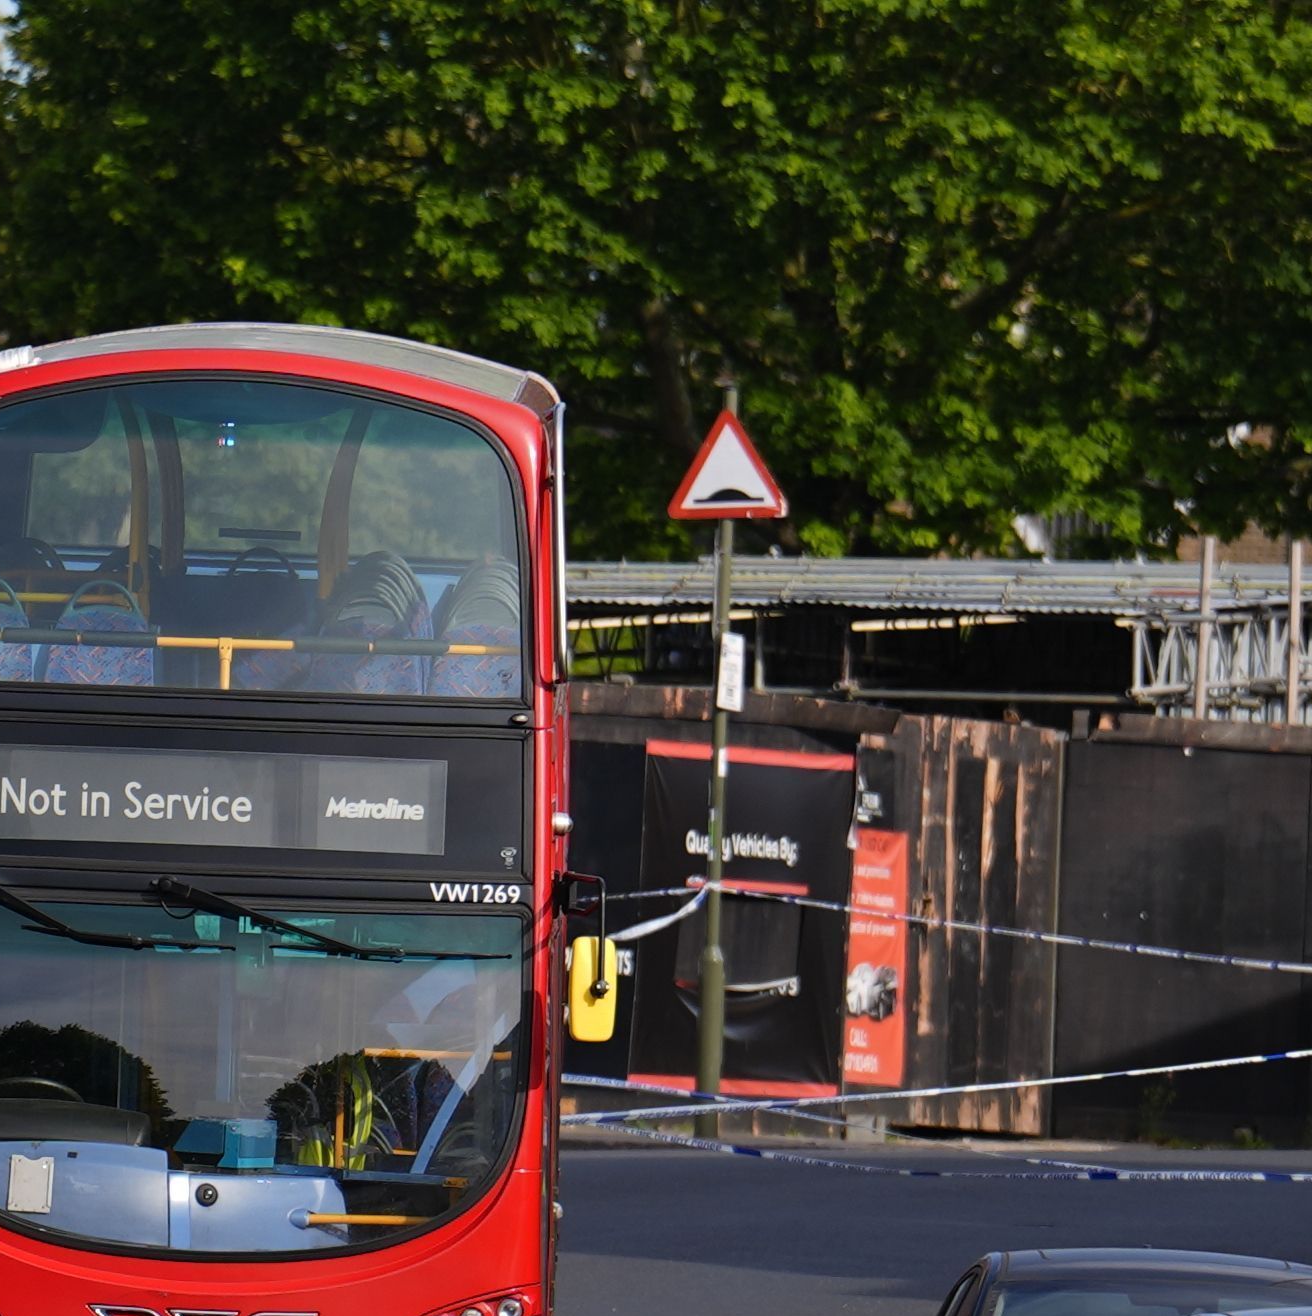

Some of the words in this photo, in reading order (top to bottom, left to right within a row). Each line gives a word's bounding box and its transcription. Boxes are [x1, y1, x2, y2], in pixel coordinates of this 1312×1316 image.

[0, 777, 66, 816] Not
[81, 782, 110, 817] in
[124, 781, 252, 822] Service
[325, 796, 425, 821] Metroline
[686, 829, 732, 862] Quay
[732, 832, 779, 860] Vehicles
[430, 883, 521, 904] VW1269
